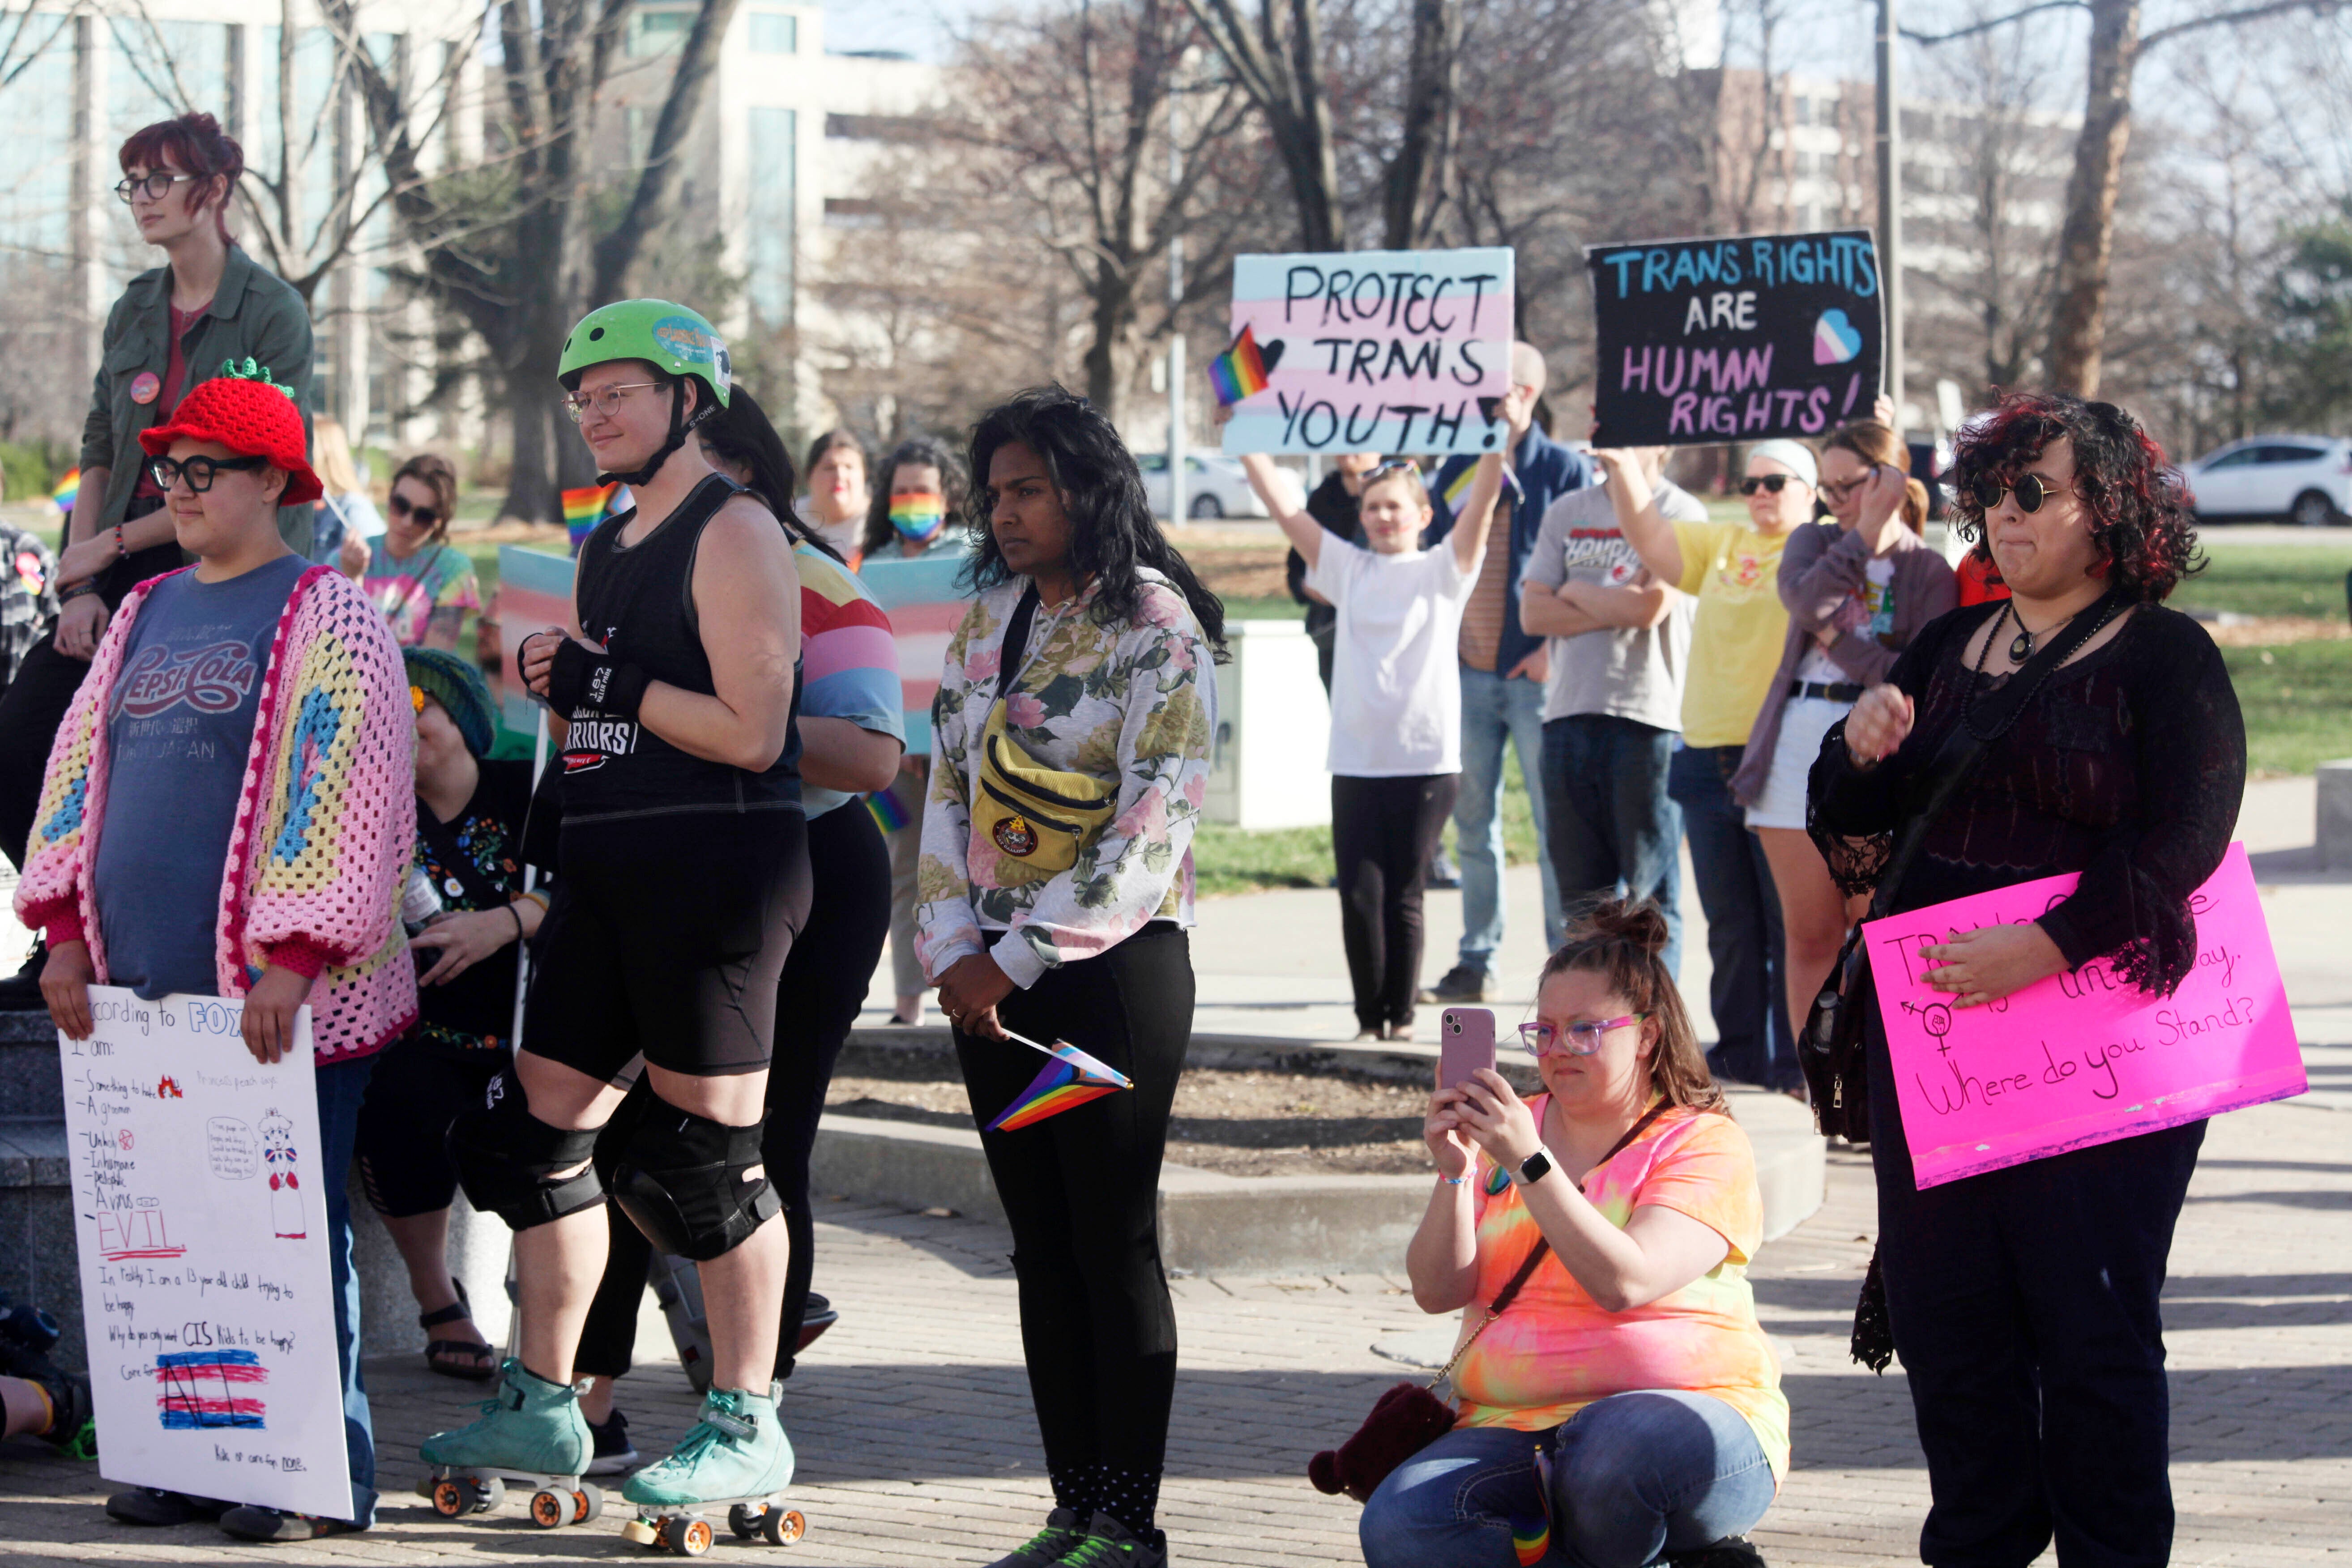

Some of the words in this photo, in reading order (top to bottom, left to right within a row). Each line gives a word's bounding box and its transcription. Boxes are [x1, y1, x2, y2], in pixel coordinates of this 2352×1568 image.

[1603, 242, 1741, 299] TRANS
[1753, 237, 1877, 297] RIGHTS
[1285, 266, 1498, 335] PROTECT
[1683, 291, 1757, 336] ARE
[1313, 338, 1484, 386] TRANS
[1622, 343, 1774, 397] HUMAN
[589, 667, 604, 699] 187
[596, 684, 606, 703] KILLER
[602, 668, 612, 684] PADS
[158, 741, 215, 759] JAAN
[88, 998, 149, 1036] cording
[158, 999, 175, 1026] to
[188, 1002, 244, 1037] FOX
[1916, 1059, 2033, 1116] Where
[2042, 1040, 2077, 1084] do
[2084, 1037, 2145, 1099] you
[2155, 997, 2254, 1046] Stand?
[131, 1078, 139, 1095] to
[88, 1095, 97, 1116] A
[97, 1187, 107, 1209] A
[98, 1266, 115, 1286] In
[146, 1268, 155, 1285] I
[175, 1275, 182, 1286] a
[283, 1283, 294, 1300] to
[103, 1292, 115, 1312] be
[108, 1325, 125, 1349] Why
[183, 1321, 213, 1346] CIS
[239, 1325, 249, 1345] to
[255, 1329, 265, 1345] be
